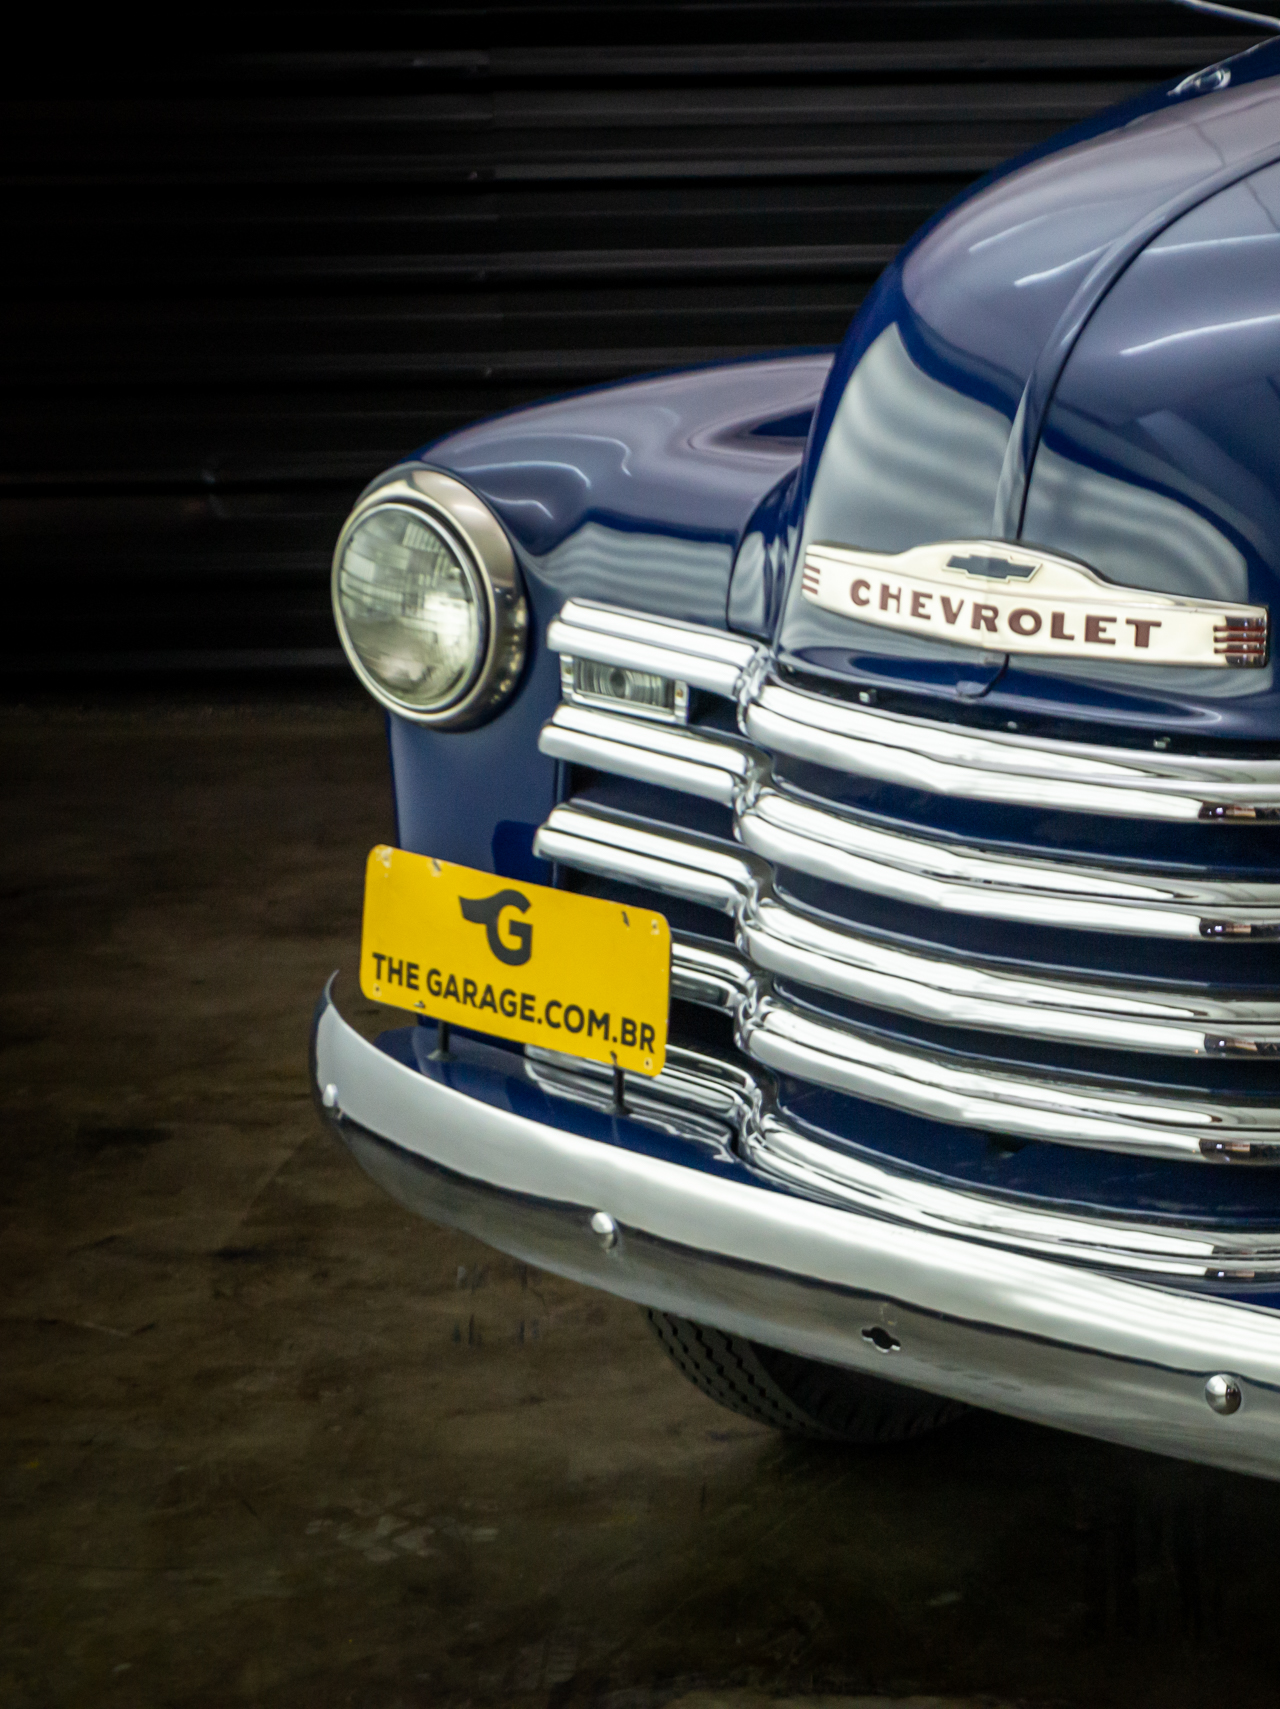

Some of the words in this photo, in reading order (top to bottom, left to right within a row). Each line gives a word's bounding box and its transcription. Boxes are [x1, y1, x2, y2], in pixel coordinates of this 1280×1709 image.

[850, 579, 1162, 648] CHEVROLET
[371, 952, 420, 991] THE
[426, 968, 656, 1053] GARAGE.COM.BR
